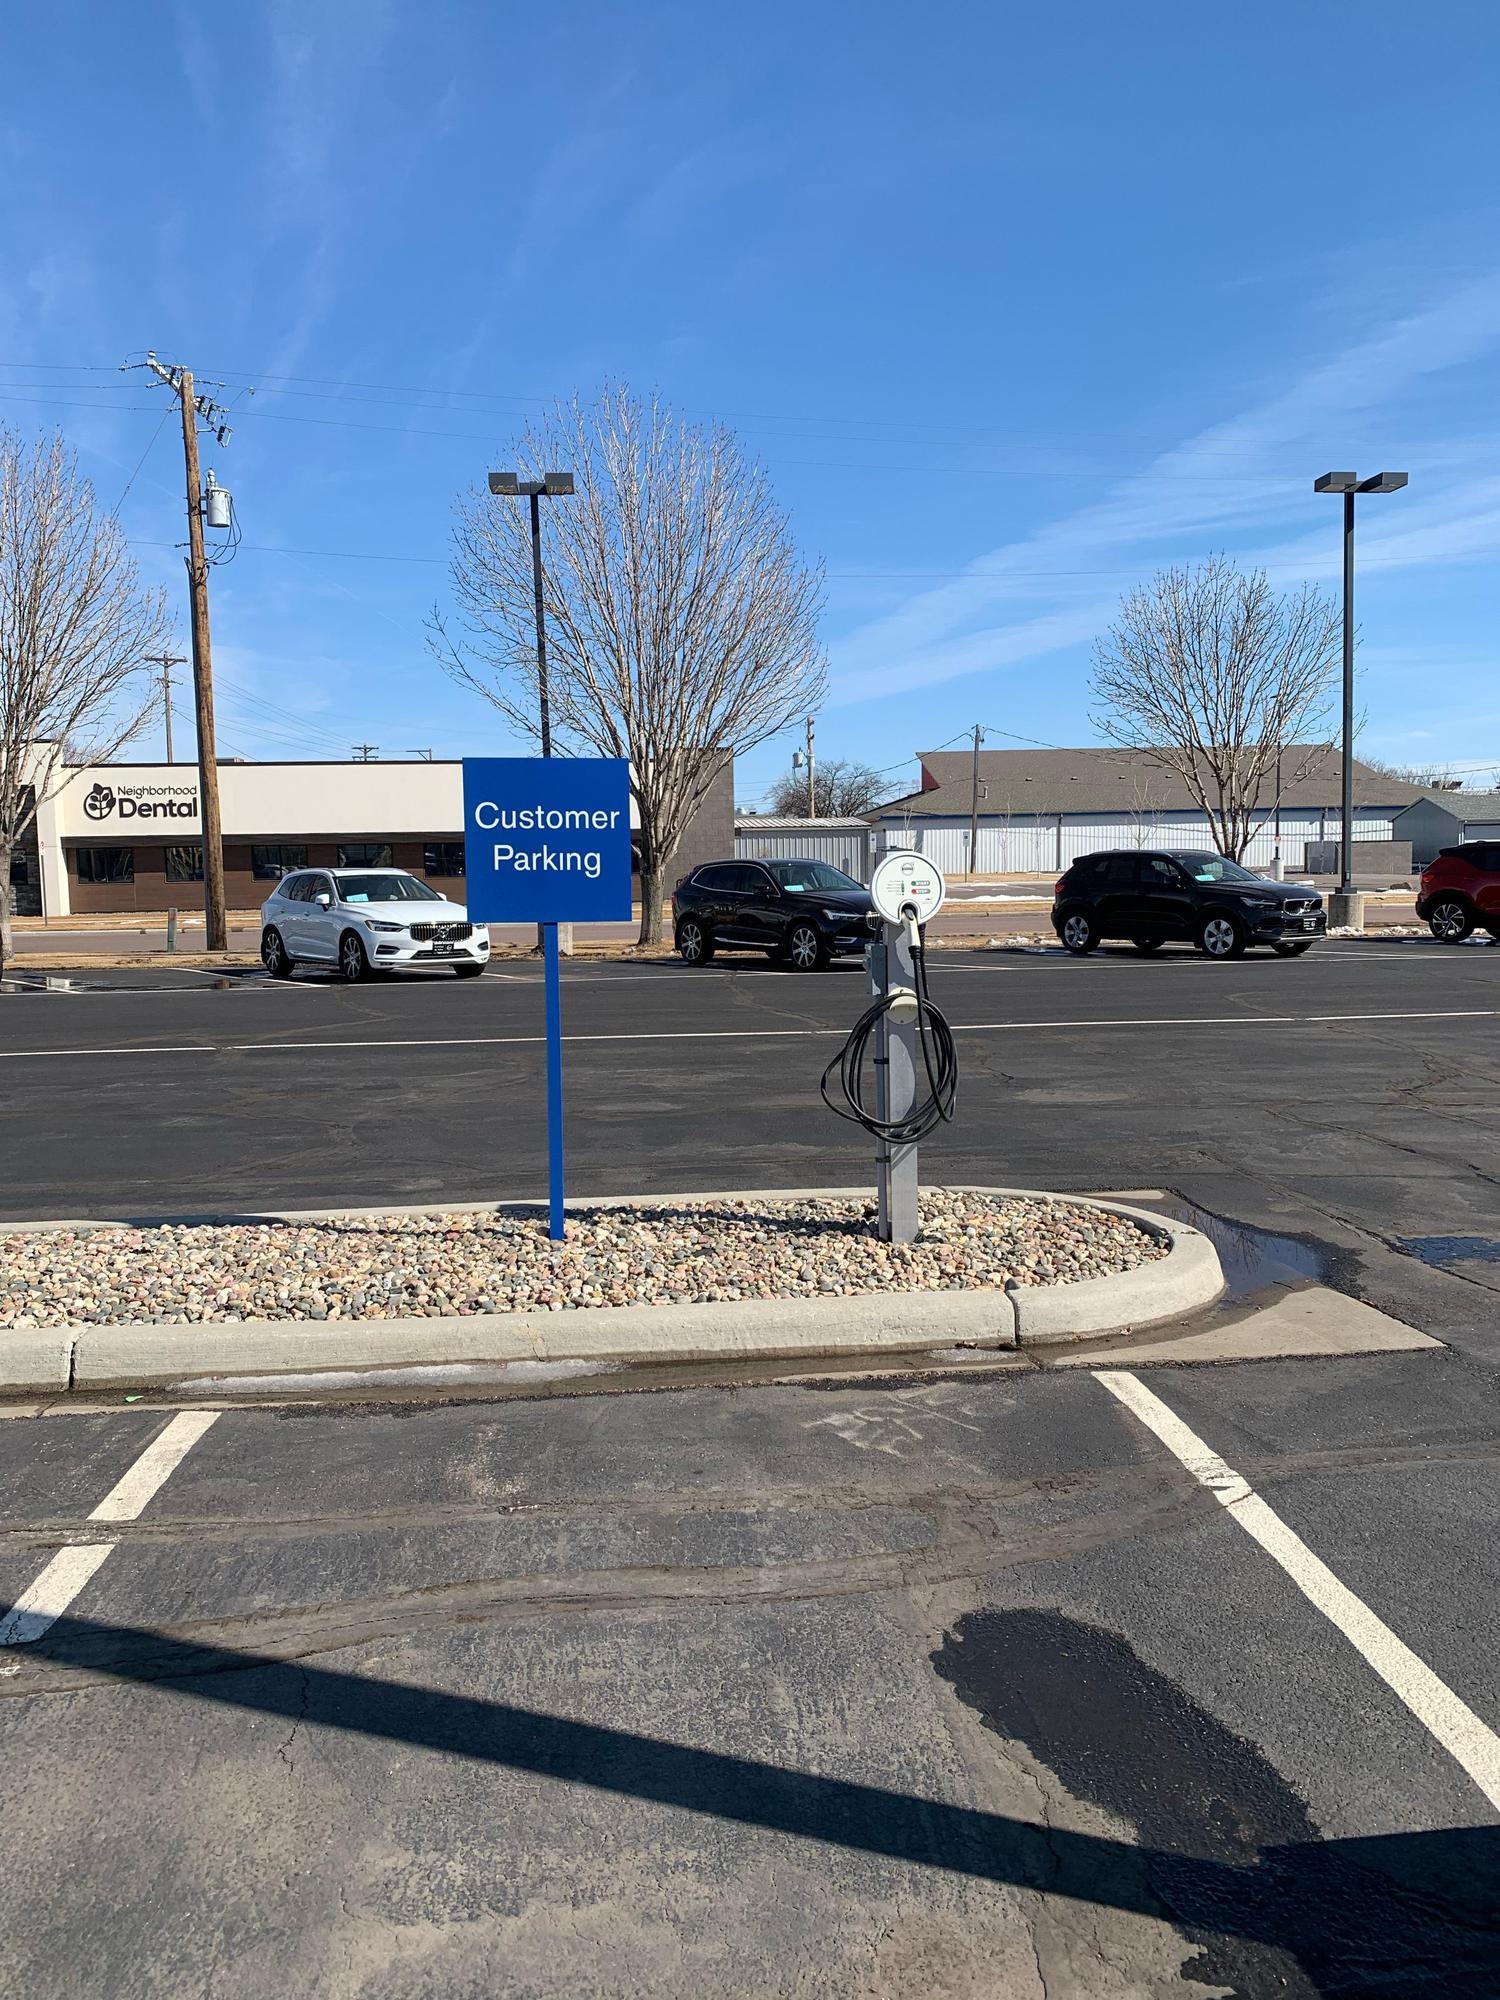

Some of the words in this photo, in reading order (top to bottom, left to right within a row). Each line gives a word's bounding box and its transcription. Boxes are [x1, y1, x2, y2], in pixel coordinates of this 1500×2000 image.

[117, 785, 197, 799] Neighborhood
[118, 797, 198, 818] Dental
[474, 801, 620, 829] Customer
[493, 844, 601, 878] Parking
